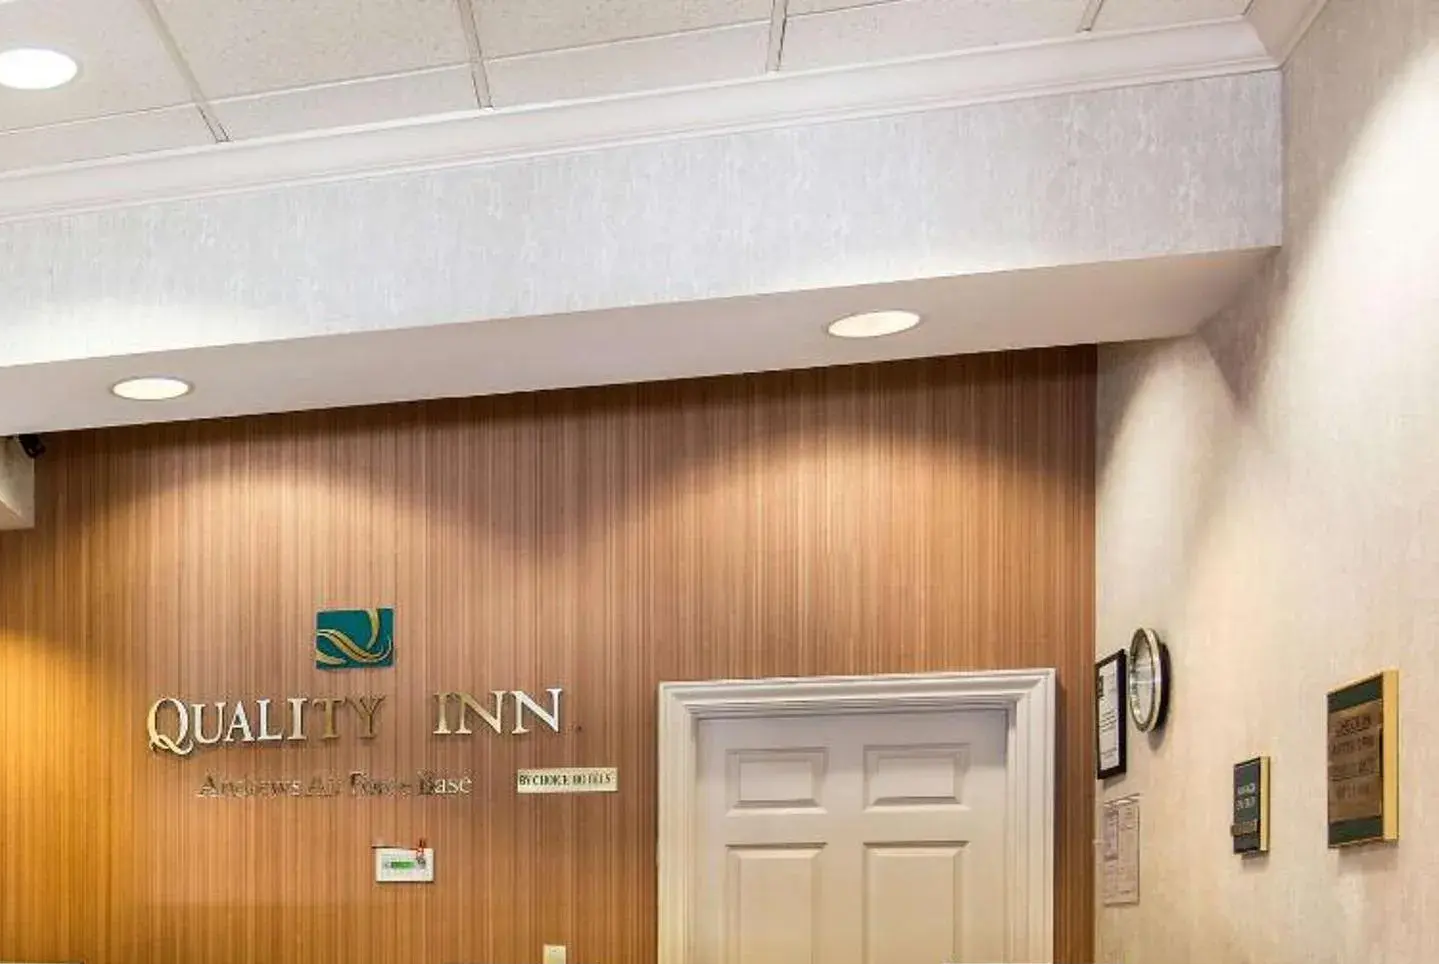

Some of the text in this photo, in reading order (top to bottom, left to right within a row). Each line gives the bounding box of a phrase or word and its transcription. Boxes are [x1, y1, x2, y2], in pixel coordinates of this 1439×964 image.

[146, 687, 563, 755] QUALITY INN
[417, 770, 473, 797] Base
